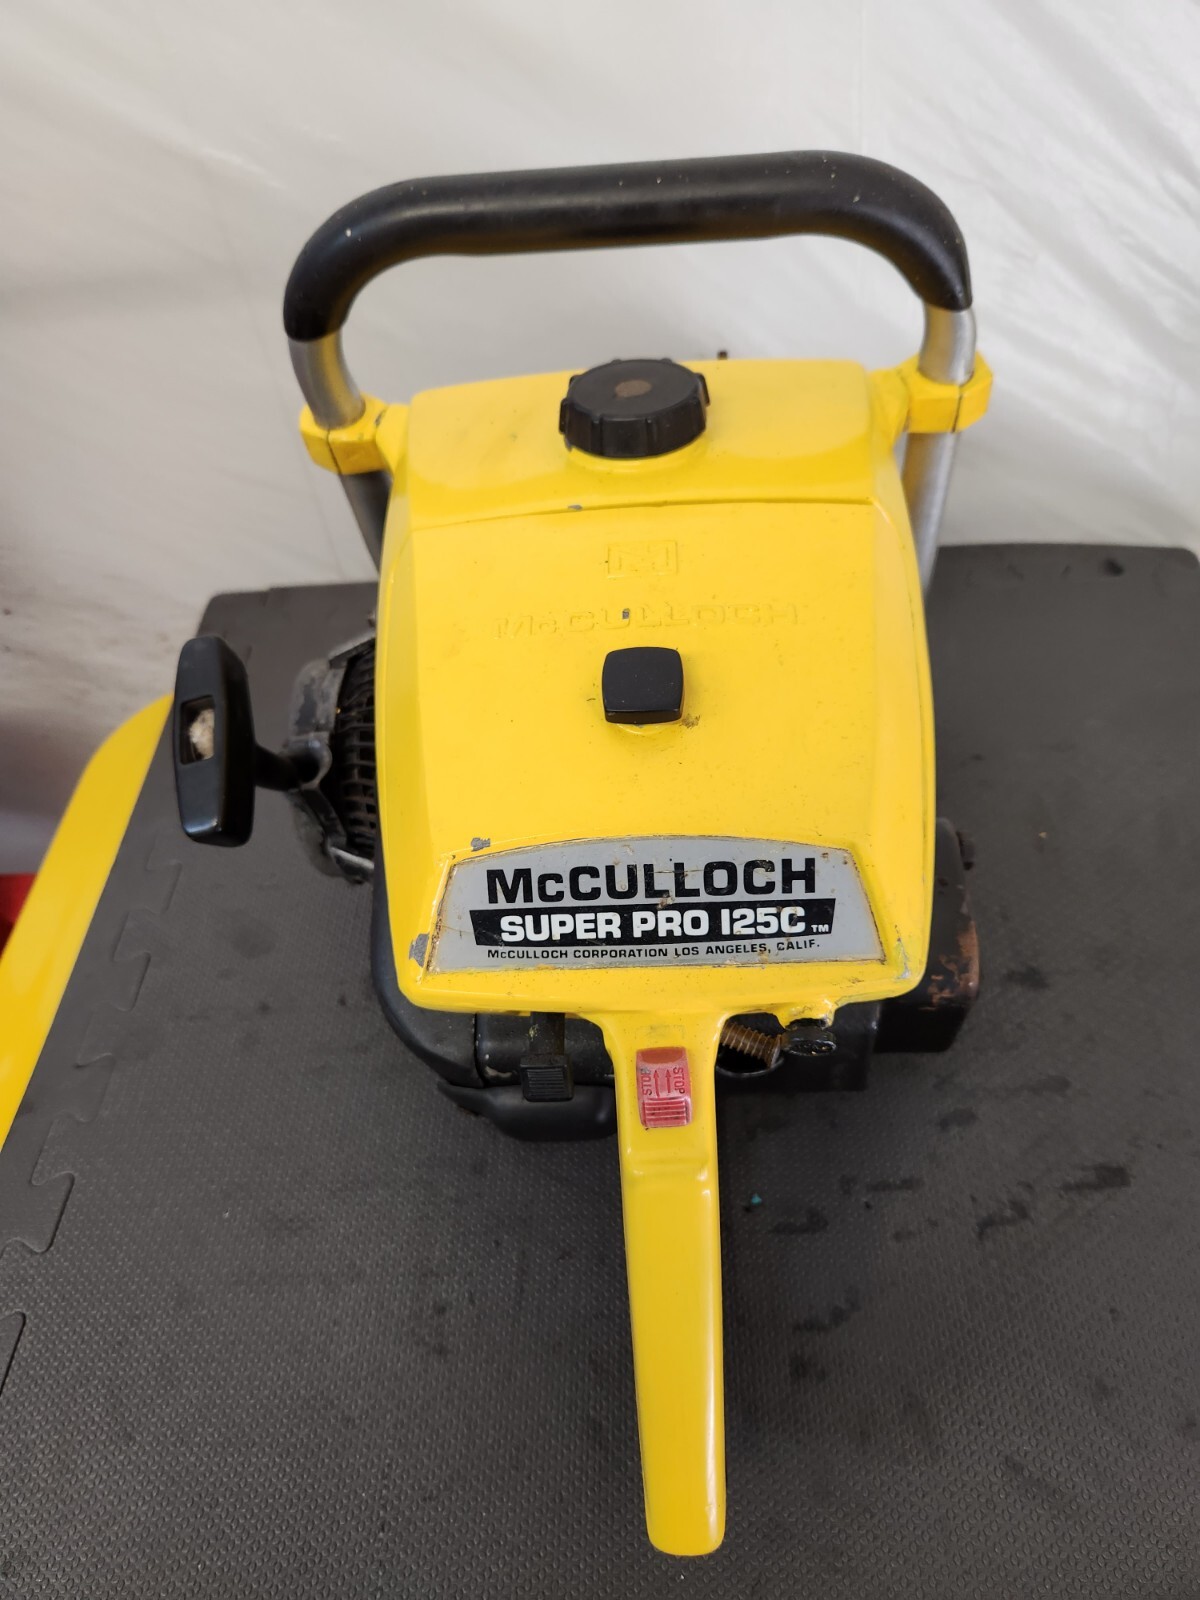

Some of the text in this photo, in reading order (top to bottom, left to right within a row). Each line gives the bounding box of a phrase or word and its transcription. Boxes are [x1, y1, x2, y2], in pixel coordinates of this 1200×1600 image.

[486, 857, 816, 904] McCULLOCH
[500, 912, 622, 943] SUPER
[632, 909, 709, 938] PRO
[721, 906, 806, 936] 125C
[487, 939, 821, 960] McCULLOCH CORPORATION LOS ANGELES, CALIF.
[673, 1066, 686, 1095] STOP
